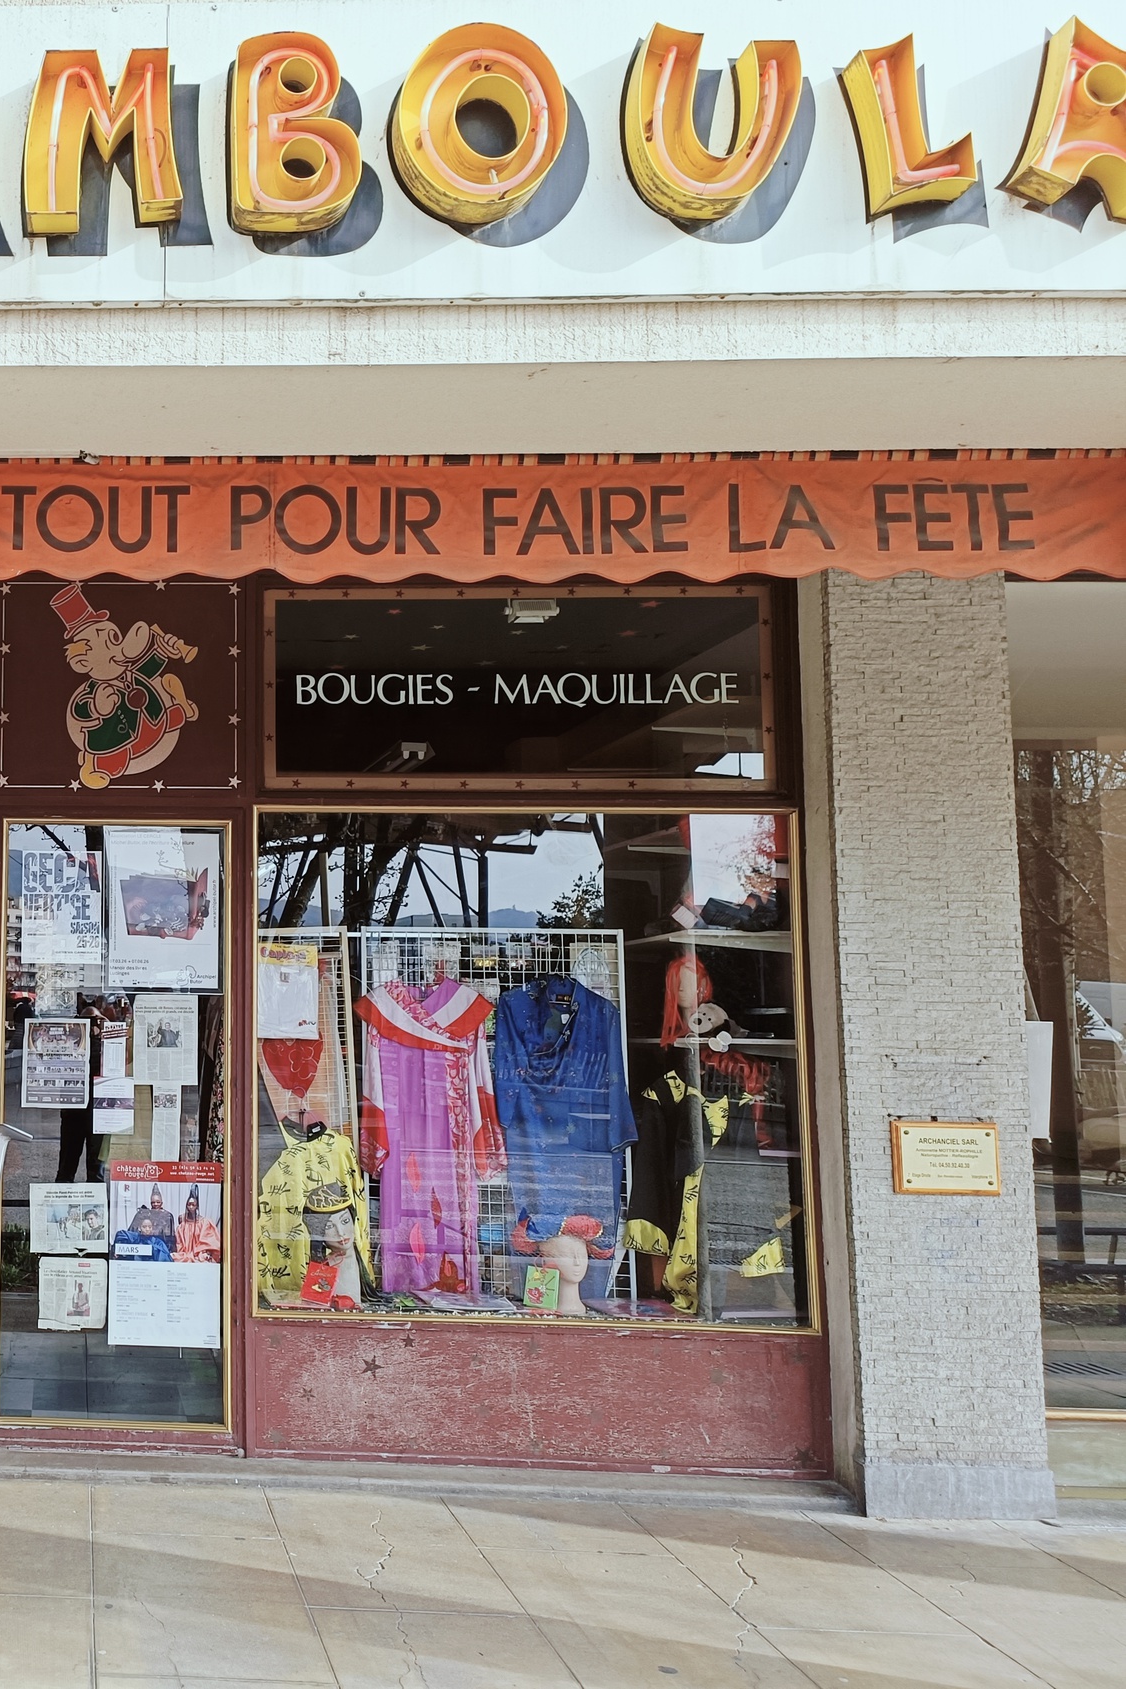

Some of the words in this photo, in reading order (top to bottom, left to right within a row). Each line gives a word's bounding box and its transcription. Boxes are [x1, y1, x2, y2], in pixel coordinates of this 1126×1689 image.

[1, 485, 191, 553] TOUT
[230, 484, 442, 556] POUR
[481, 486, 689, 556] FAIRE
[727, 483, 836, 553] LA
[874, 477, 1036, 552] FÊTE
[295, 673, 454, 706] BOUGIES
[493, 672, 740, 707] MAQUILLAGE
[70, 921, 100, 935] SAISON
[117, 1164, 144, 1172] château
[124, 1171, 144, 1179] rouge
